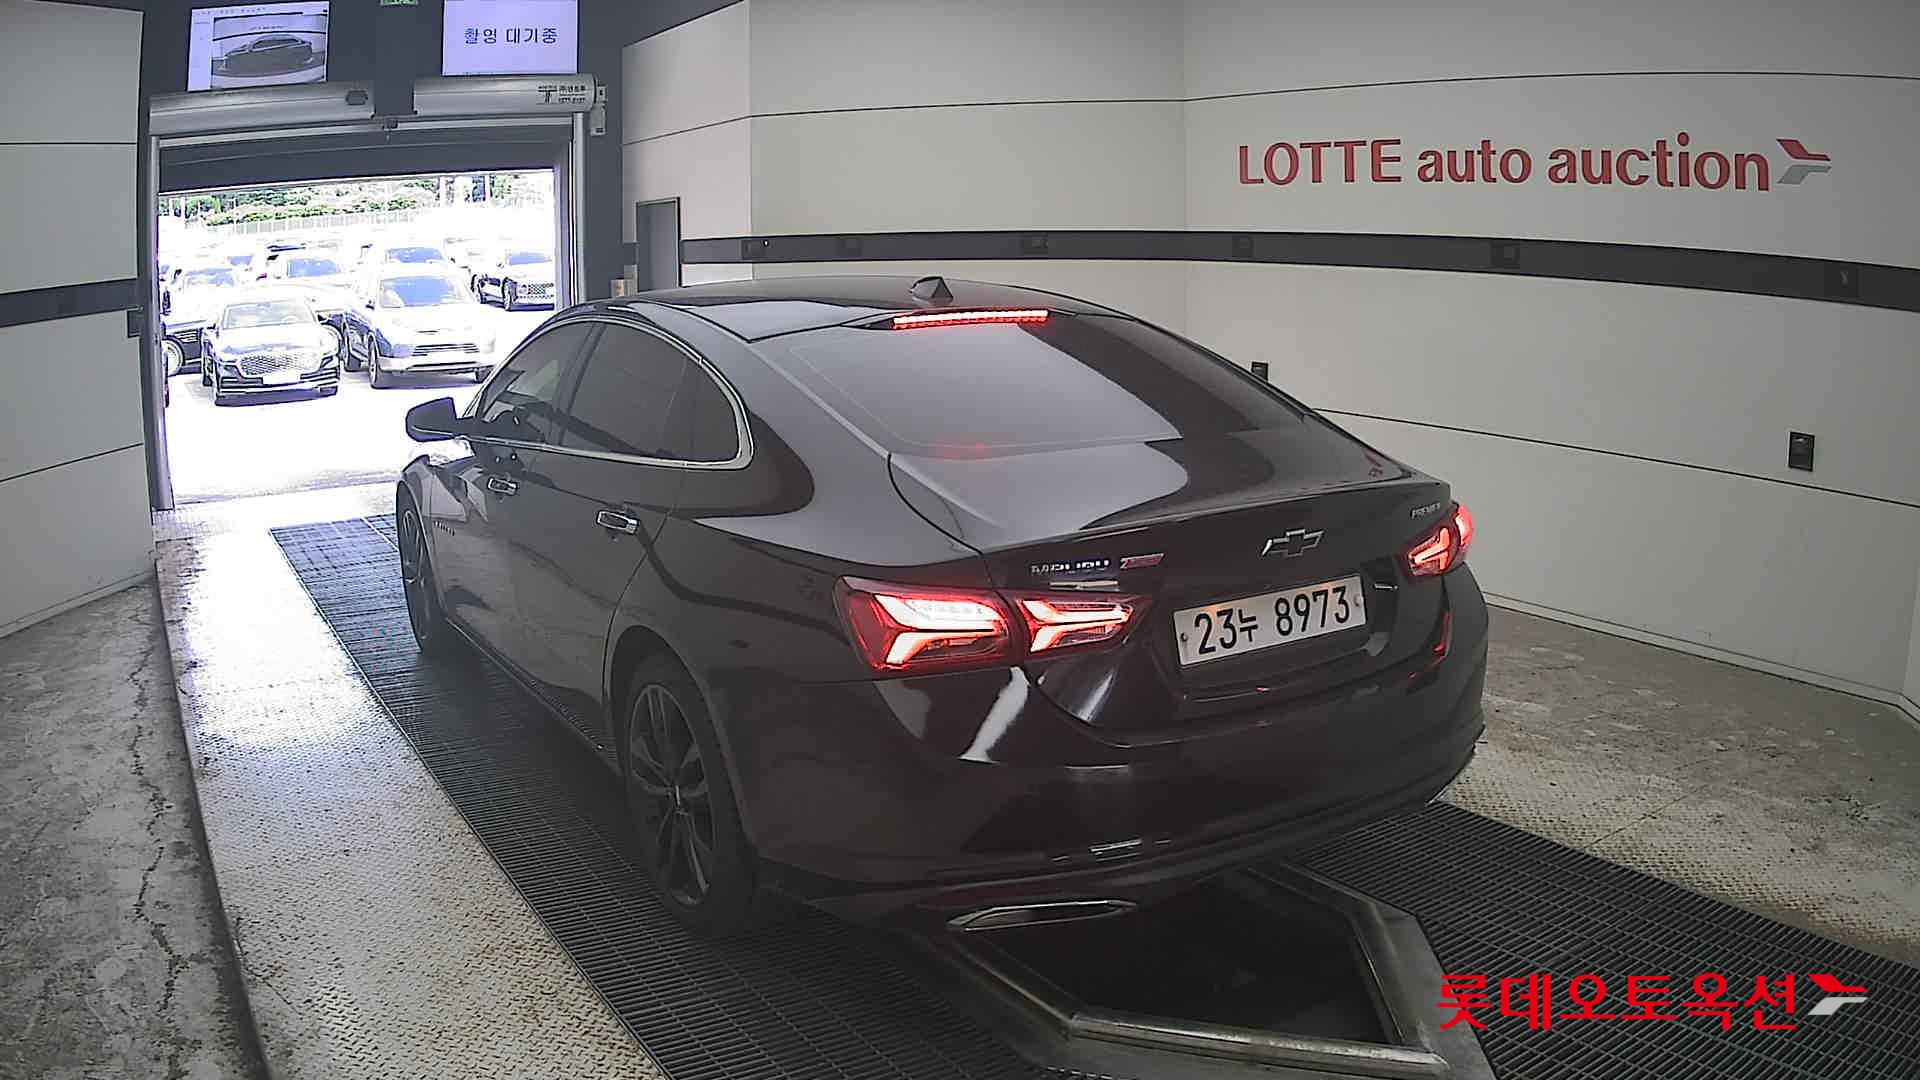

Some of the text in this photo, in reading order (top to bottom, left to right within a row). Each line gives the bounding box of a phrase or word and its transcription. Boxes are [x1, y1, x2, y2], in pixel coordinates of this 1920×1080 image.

[505, 27, 558, 45] 대기중
[1239, 132, 1770, 192] LOTTE auto auction
[1194, 585, 1350, 654] 23누 8973
